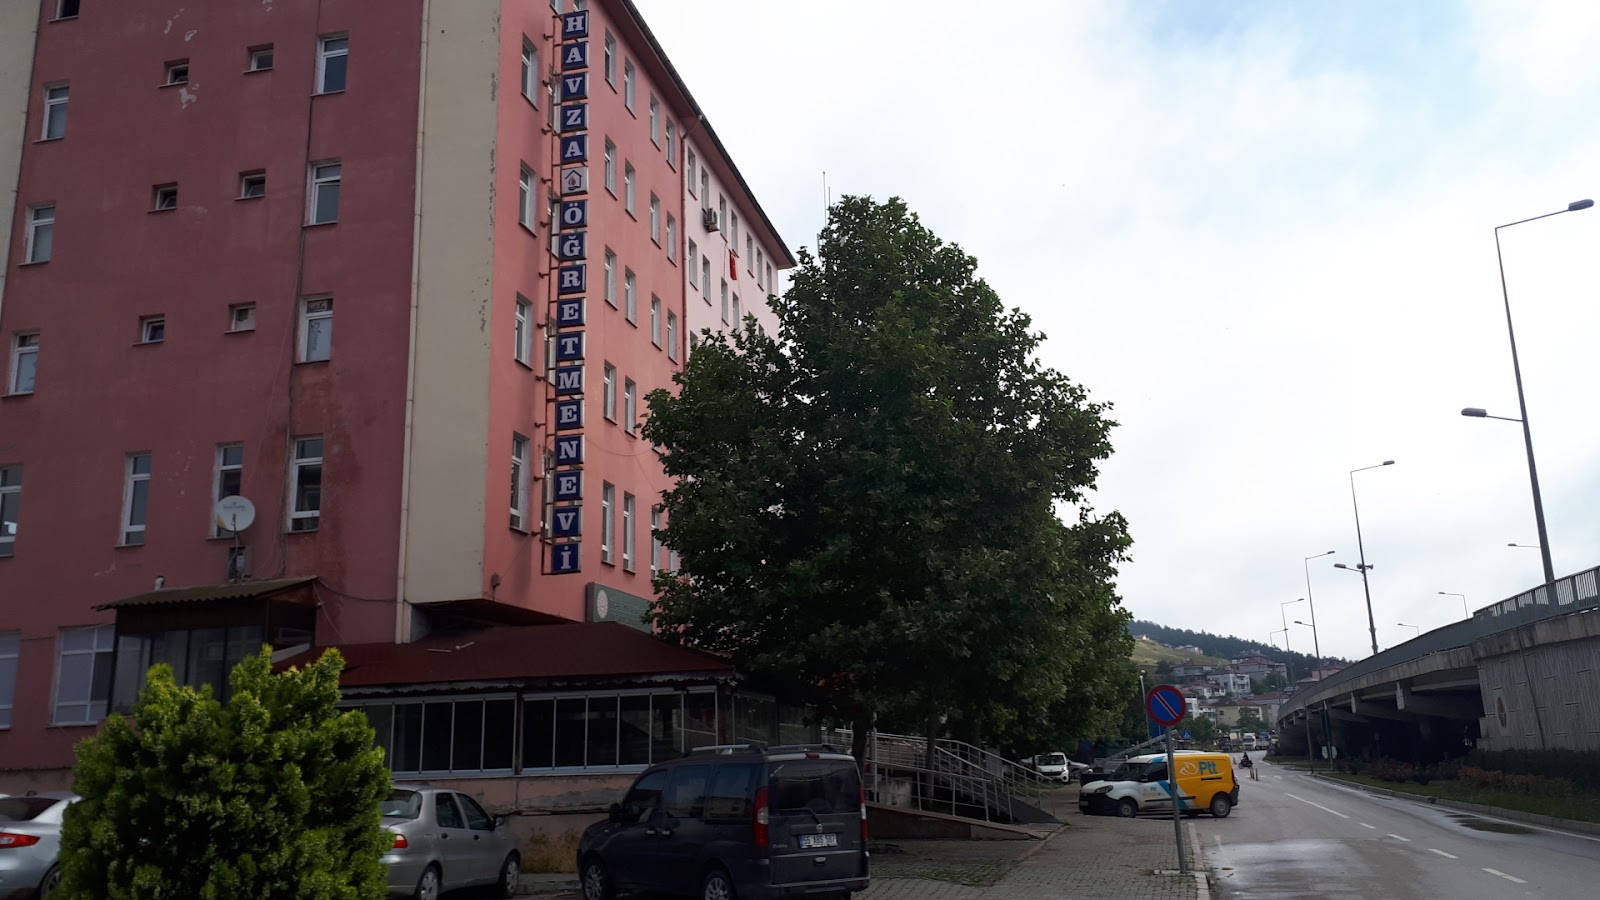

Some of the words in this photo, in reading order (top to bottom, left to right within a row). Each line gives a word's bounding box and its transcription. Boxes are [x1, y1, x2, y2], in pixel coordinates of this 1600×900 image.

[564, 16, 585, 158] HAVZA
[557, 203, 583, 569] ÖĞRETMENEVİ
[1199, 761, 1218, 775] Ptt
